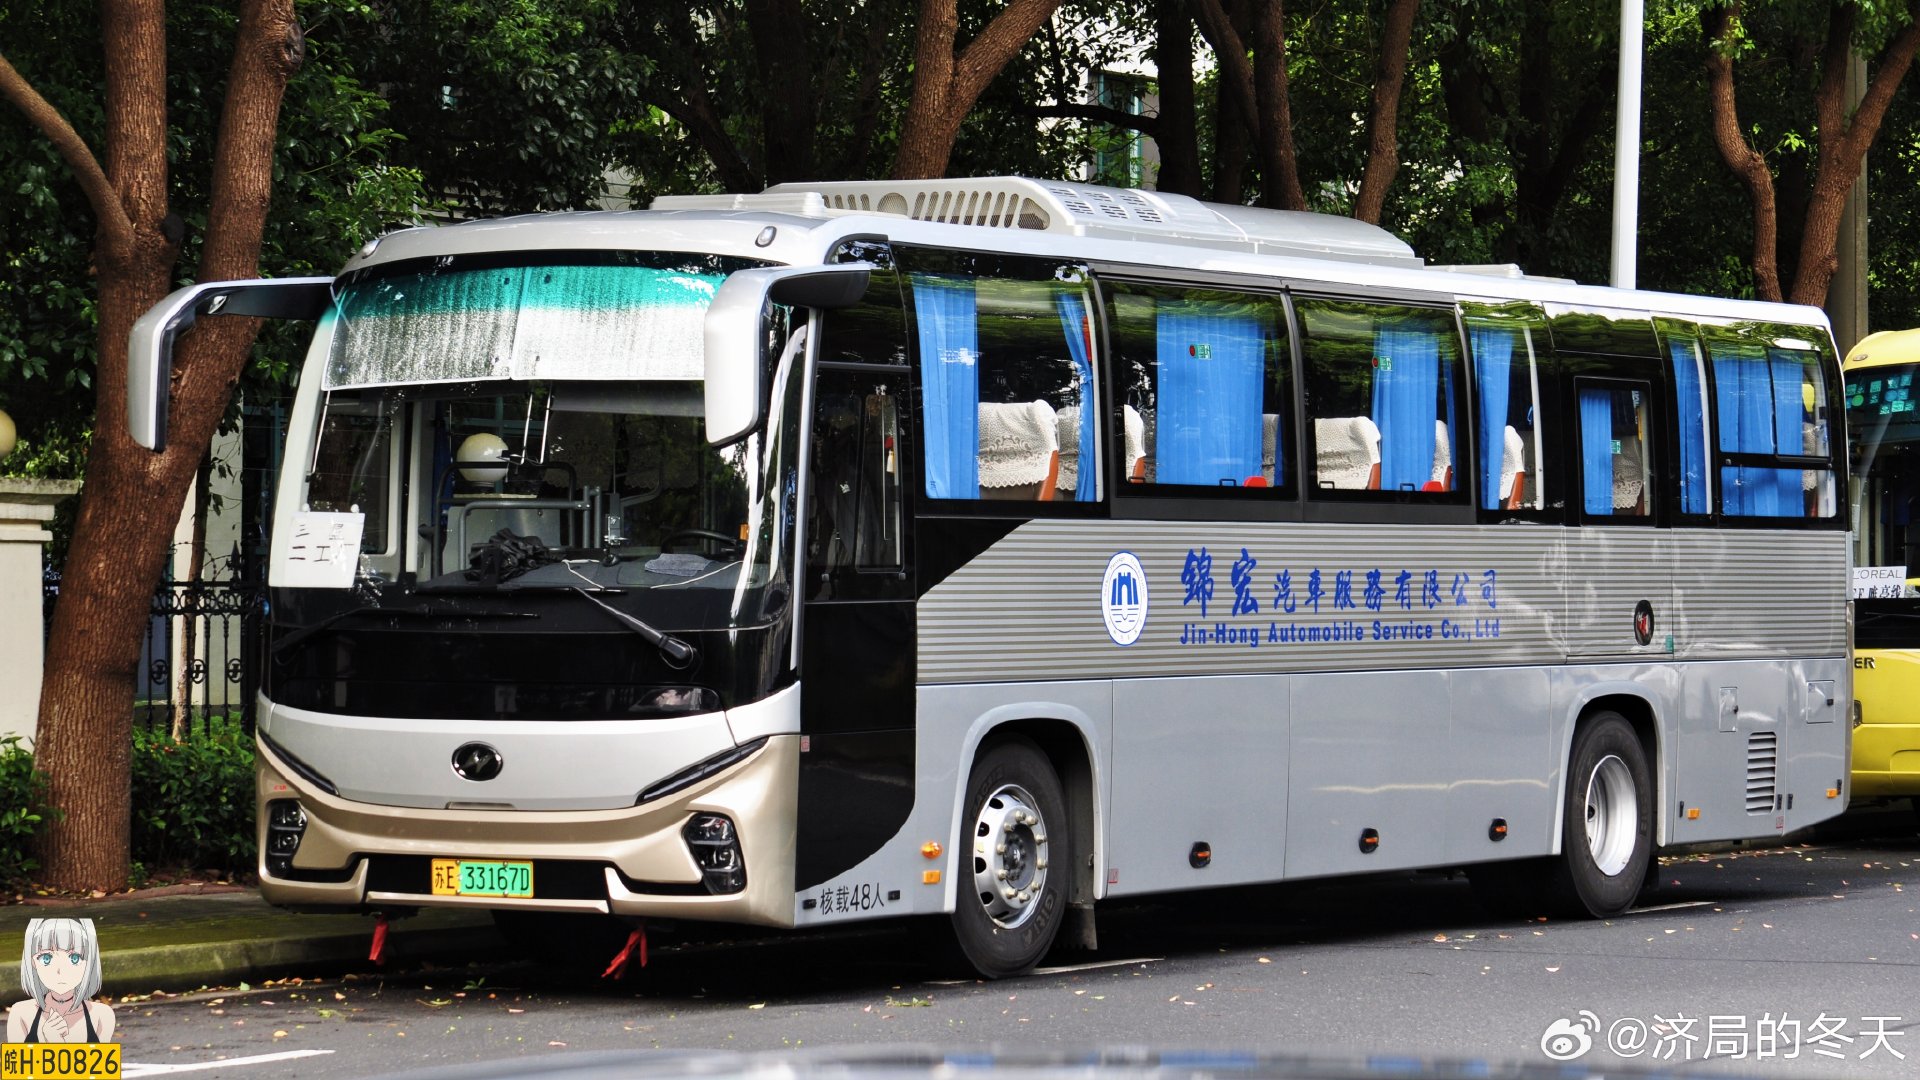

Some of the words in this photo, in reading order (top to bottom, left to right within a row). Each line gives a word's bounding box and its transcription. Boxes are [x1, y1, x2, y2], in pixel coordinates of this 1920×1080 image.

[1180, 622, 1259, 647] Jin-Hong
[1268, 620, 1364, 643] Automobile
[1372, 619, 1433, 641] Service
[819, 882, 885, 915] 核载48人
